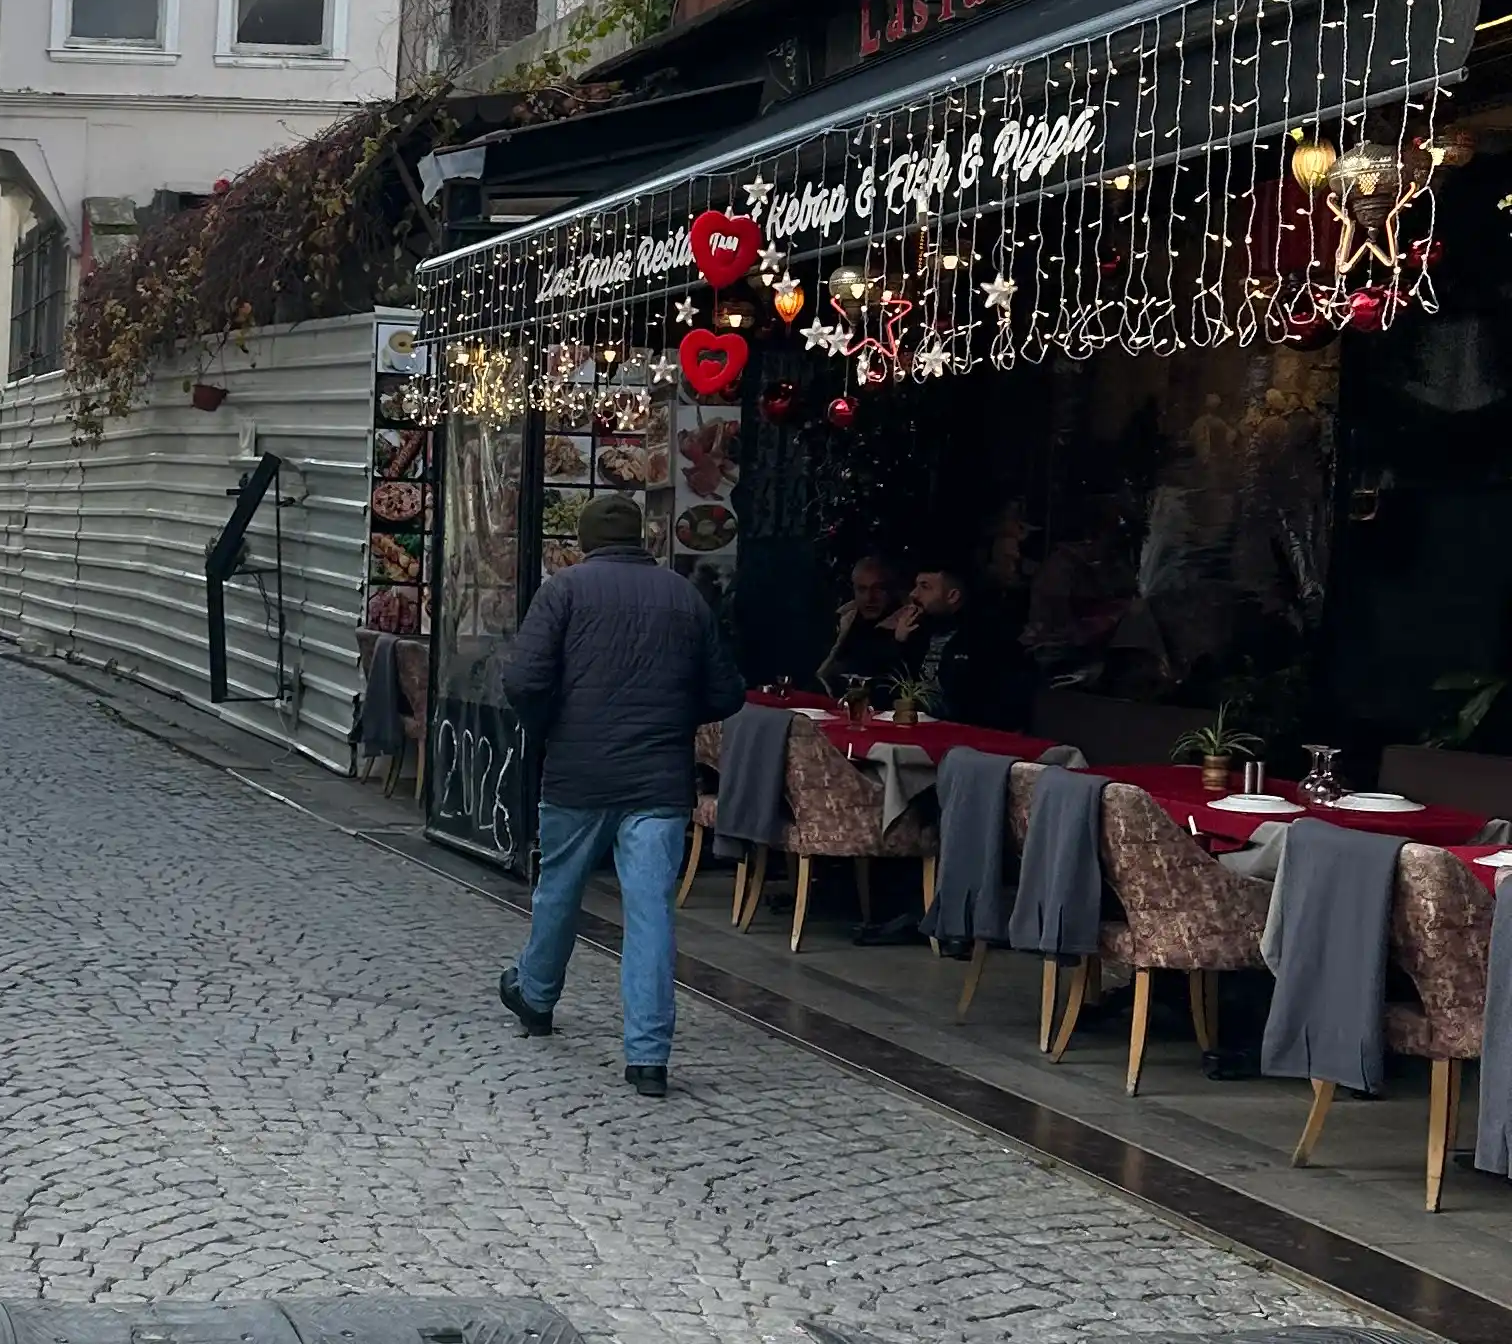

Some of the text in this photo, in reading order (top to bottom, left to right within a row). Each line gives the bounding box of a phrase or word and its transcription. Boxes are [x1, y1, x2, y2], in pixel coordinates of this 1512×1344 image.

[535, 264, 574, 304] Las
[577, 249, 634, 298] Tapas
[766, 181, 849, 240] Kebap
[991, 108, 1097, 182] Pizza
